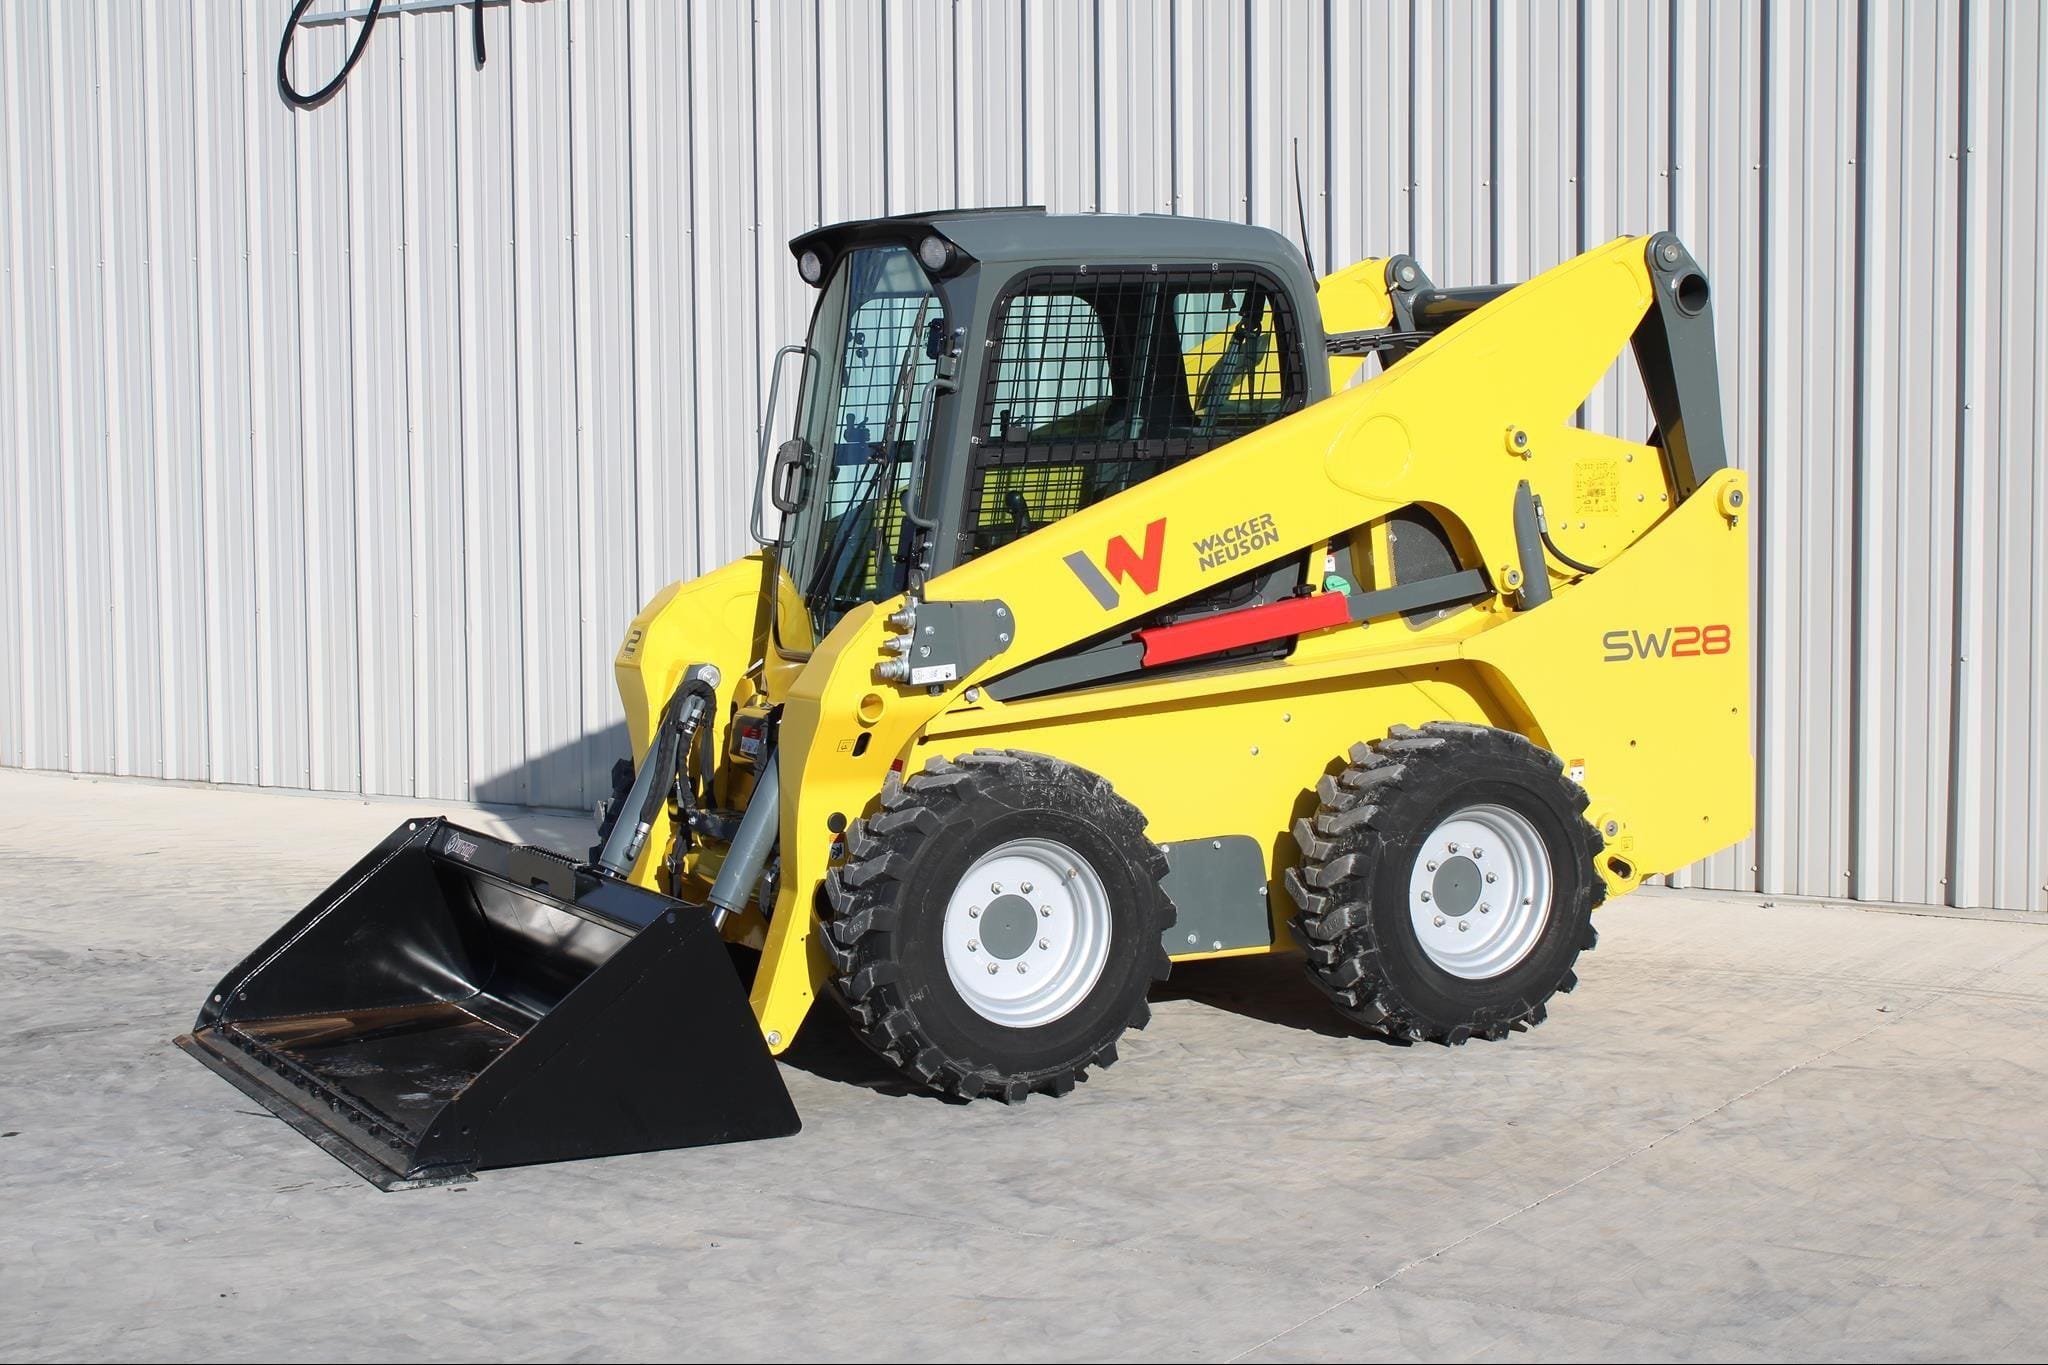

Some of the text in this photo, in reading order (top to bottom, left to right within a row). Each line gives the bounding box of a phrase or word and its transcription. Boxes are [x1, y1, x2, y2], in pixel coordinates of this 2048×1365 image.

[1193, 513, 1275, 554] WACKER
[1199, 528, 1279, 572] NEUSON
[1603, 624, 1731, 662] SW28
